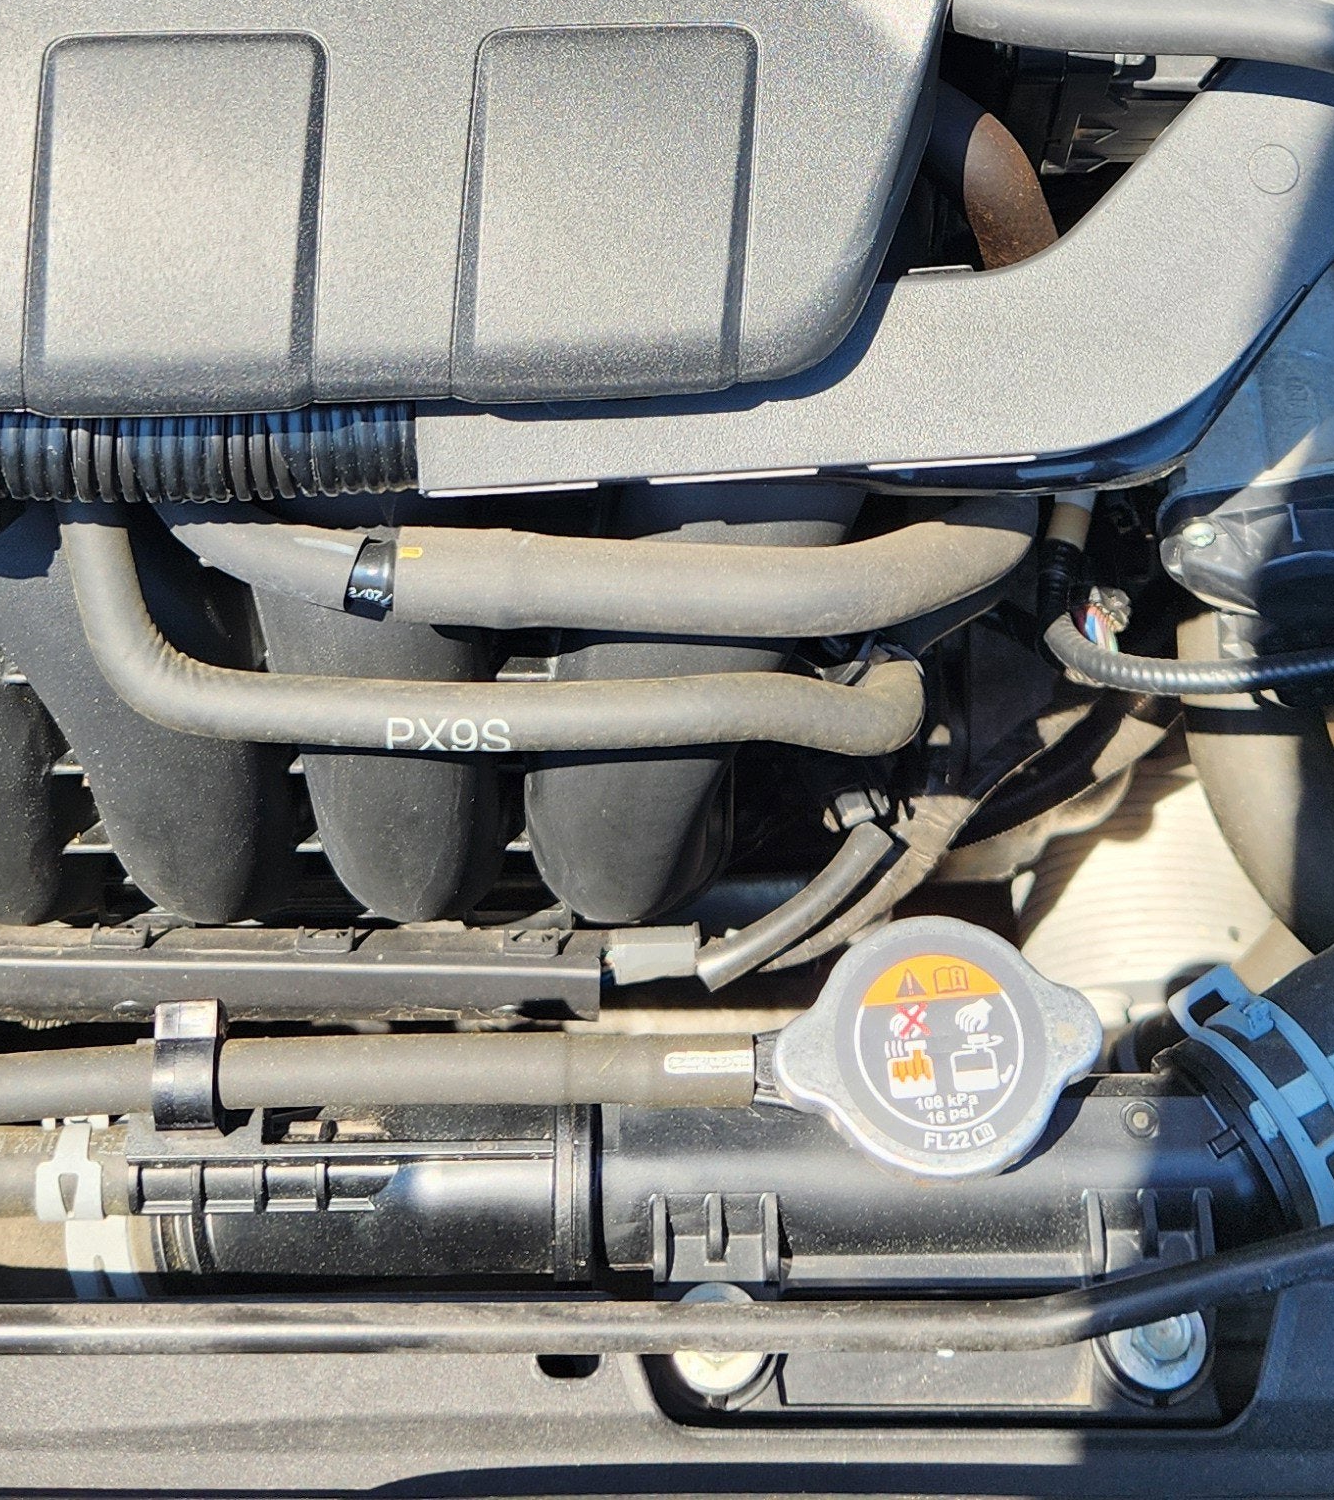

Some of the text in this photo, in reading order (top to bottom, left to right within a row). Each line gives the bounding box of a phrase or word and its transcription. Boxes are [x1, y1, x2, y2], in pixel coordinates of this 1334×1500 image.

[386, 717, 511, 752] PX9S
[915, 1092, 979, 1111] 108 kPa
[926, 1104, 976, 1125] 16 psi
[924, 1130, 972, 1151] FL22
